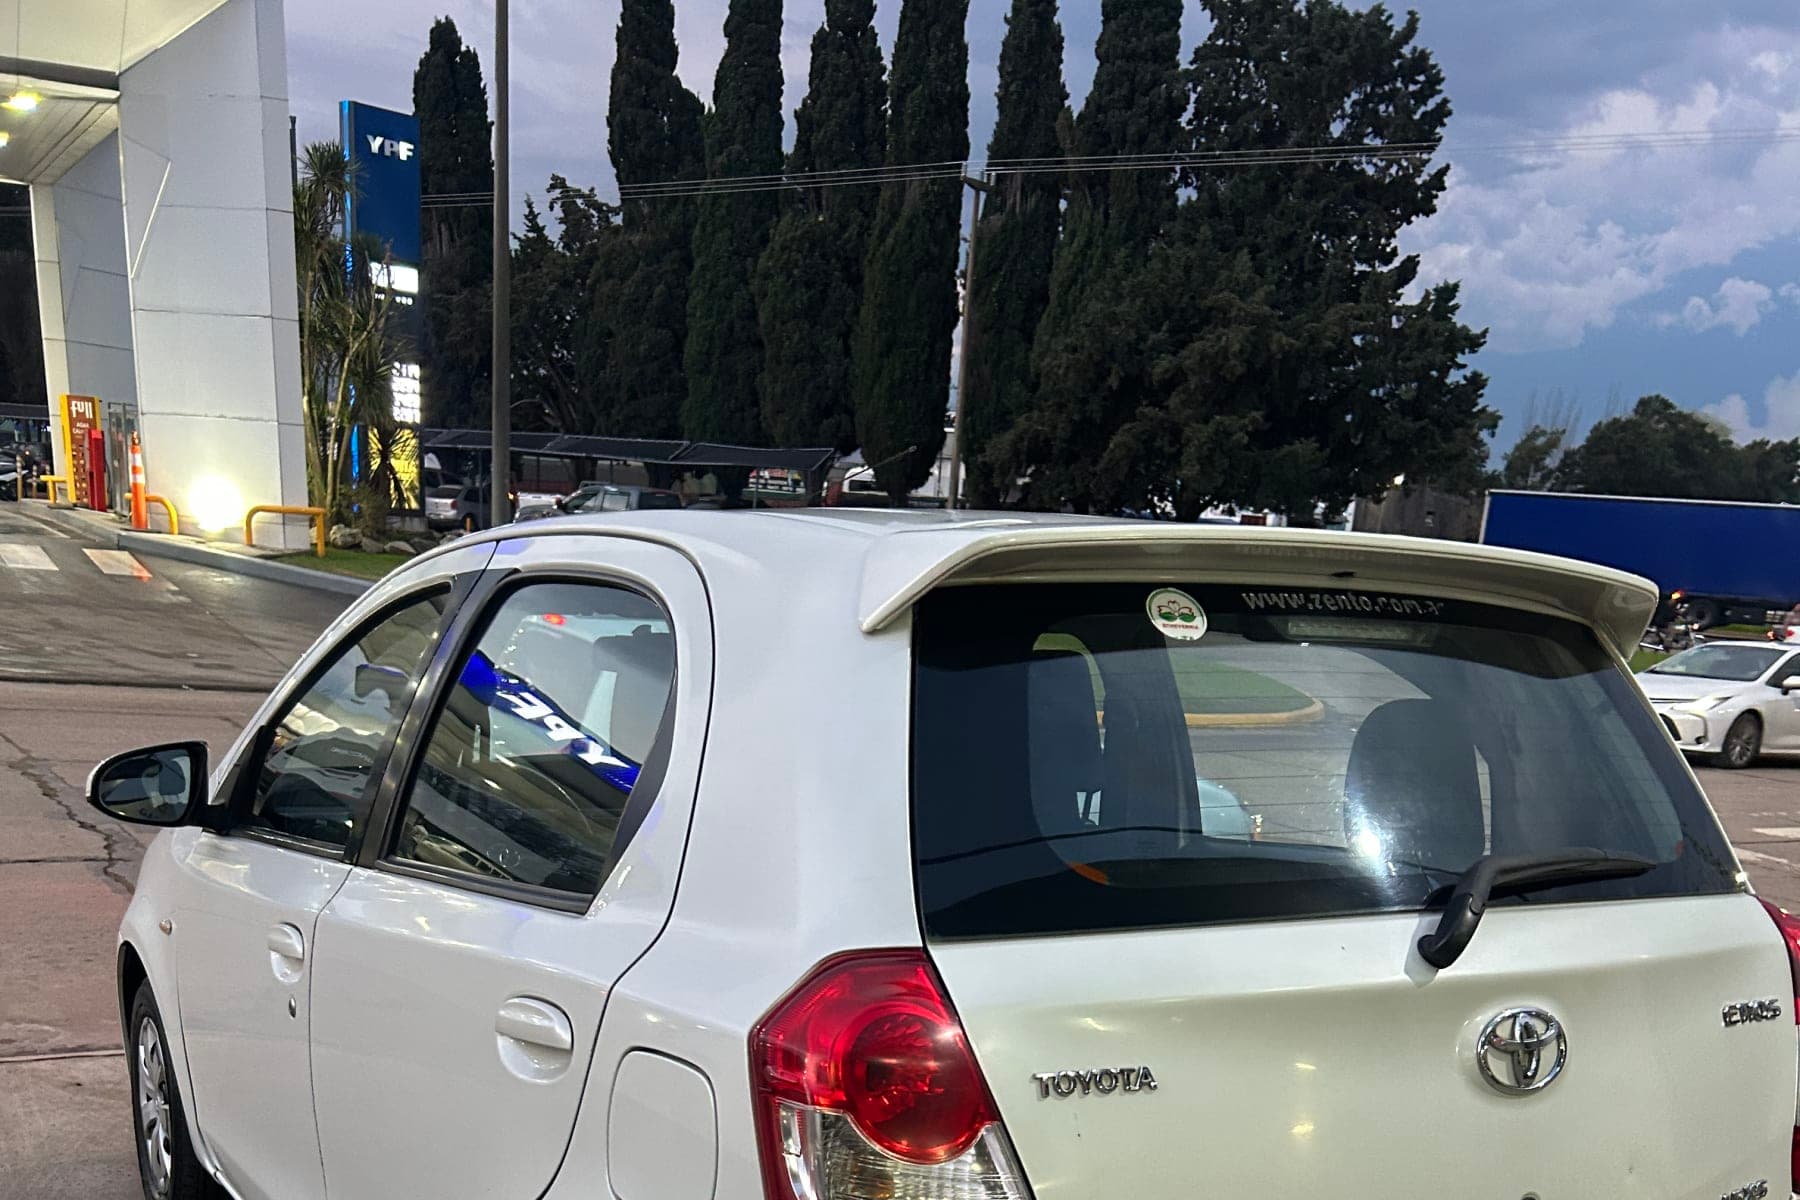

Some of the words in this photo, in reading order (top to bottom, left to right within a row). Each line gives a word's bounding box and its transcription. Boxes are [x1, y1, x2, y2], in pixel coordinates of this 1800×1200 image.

[366, 134, 415, 161] YPF
[70, 400, 93, 419] full
[1033, 1066, 1159, 1099] TOYOTA
